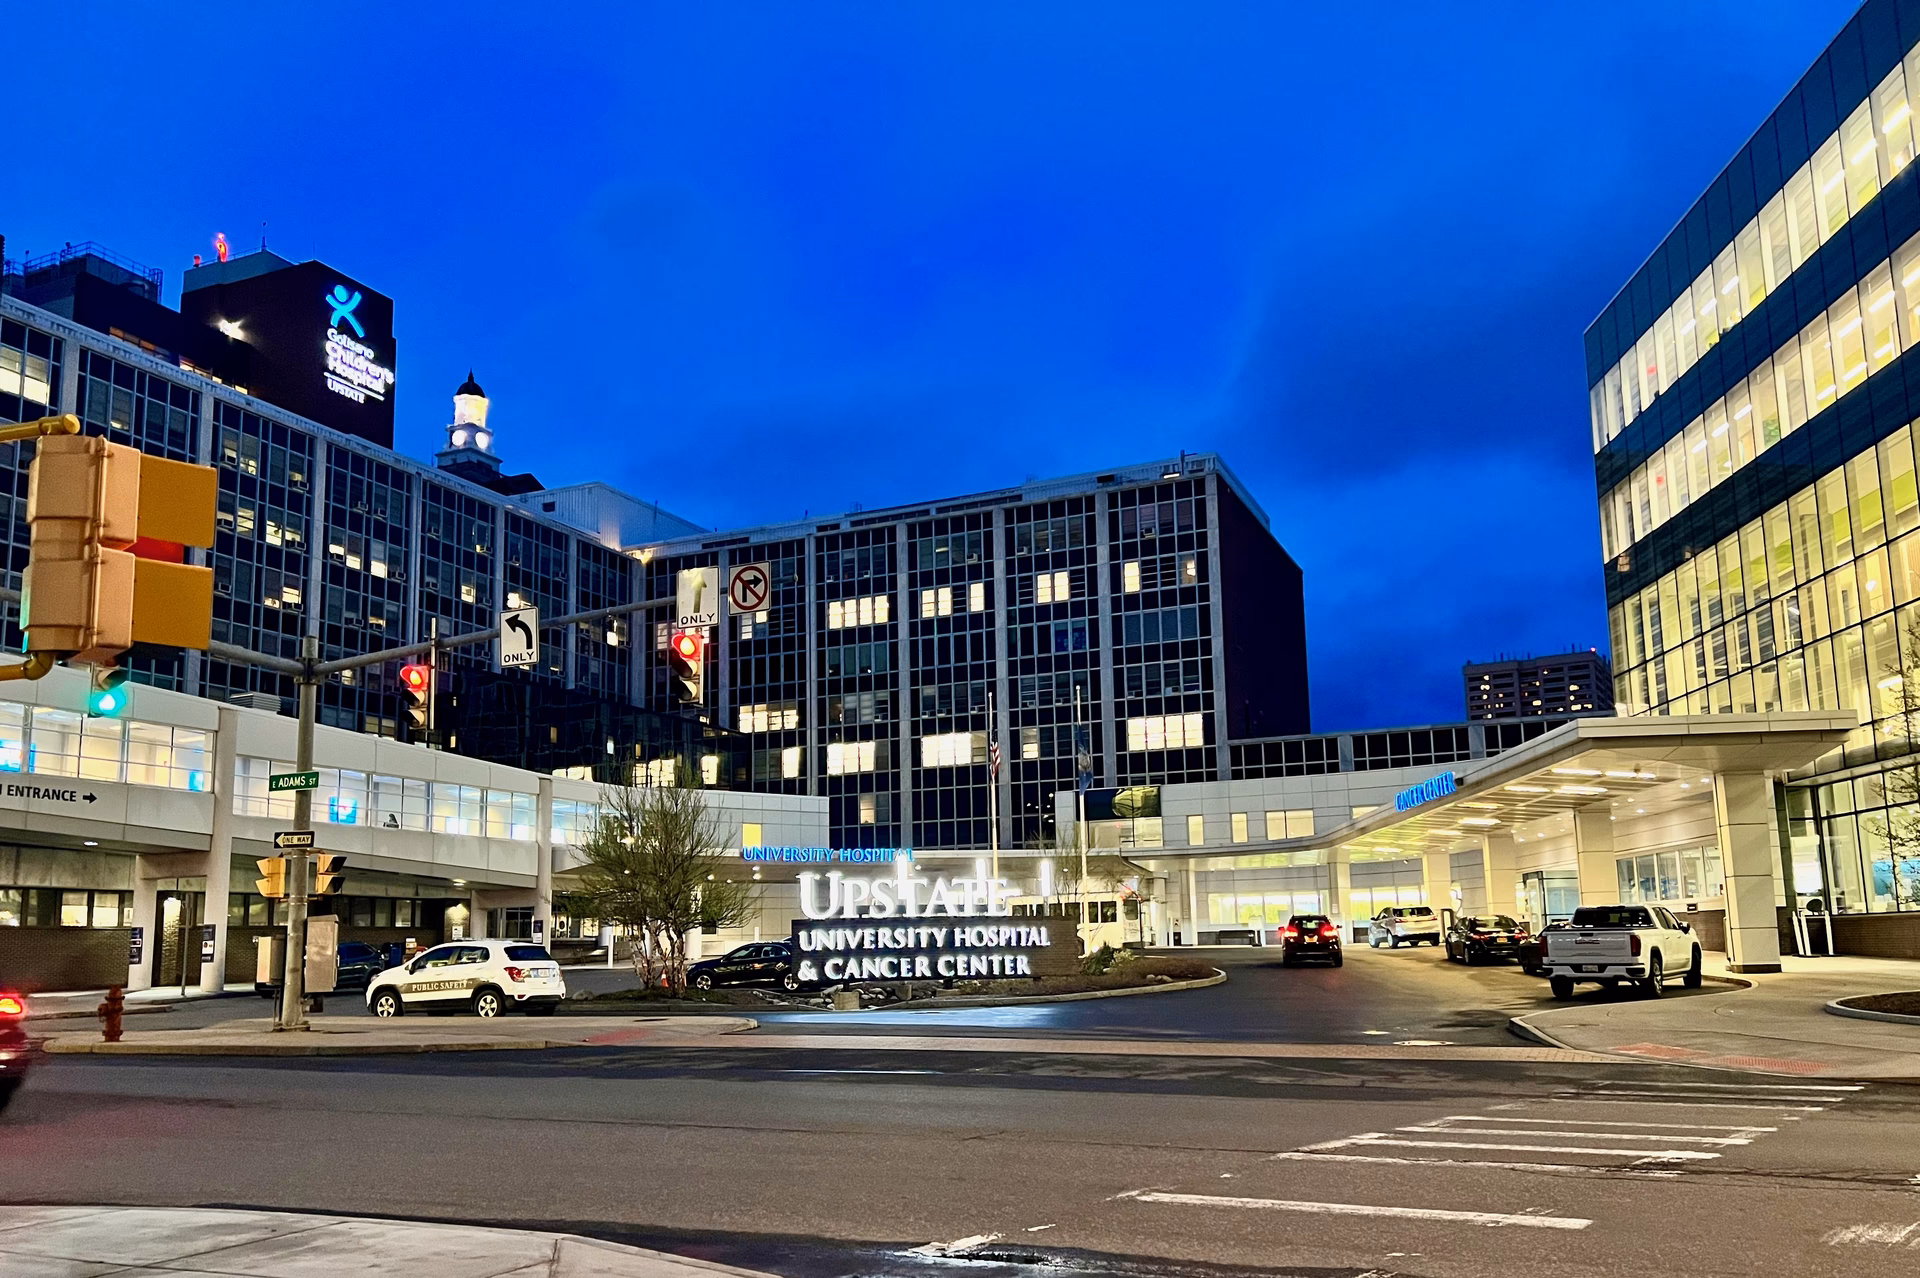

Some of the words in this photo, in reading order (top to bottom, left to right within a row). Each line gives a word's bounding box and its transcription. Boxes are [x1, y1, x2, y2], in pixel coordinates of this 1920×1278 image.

[681, 613, 715, 625] ONLY
[504, 652, 534, 663] ONLY
[278, 776, 306, 787] ADAMS
[309, 778, 316, 786] ST
[7, 784, 77, 802] ENTRANCE
[1394, 784, 1424, 812] CANCER
[1424, 770, 1456, 801] CENTER
[743, 847, 834, 862] UNIVERSITY
[799, 927, 948, 951] UNIVERSITY
[954, 925, 1051, 948] HOSPITAL
[798, 959, 818, 981] &
[824, 956, 932, 980] CANCER
[937, 954, 1031, 977] CENTER
[412, 983, 439, 991] PUBLIC
[440, 980, 467, 990] SAFETY
